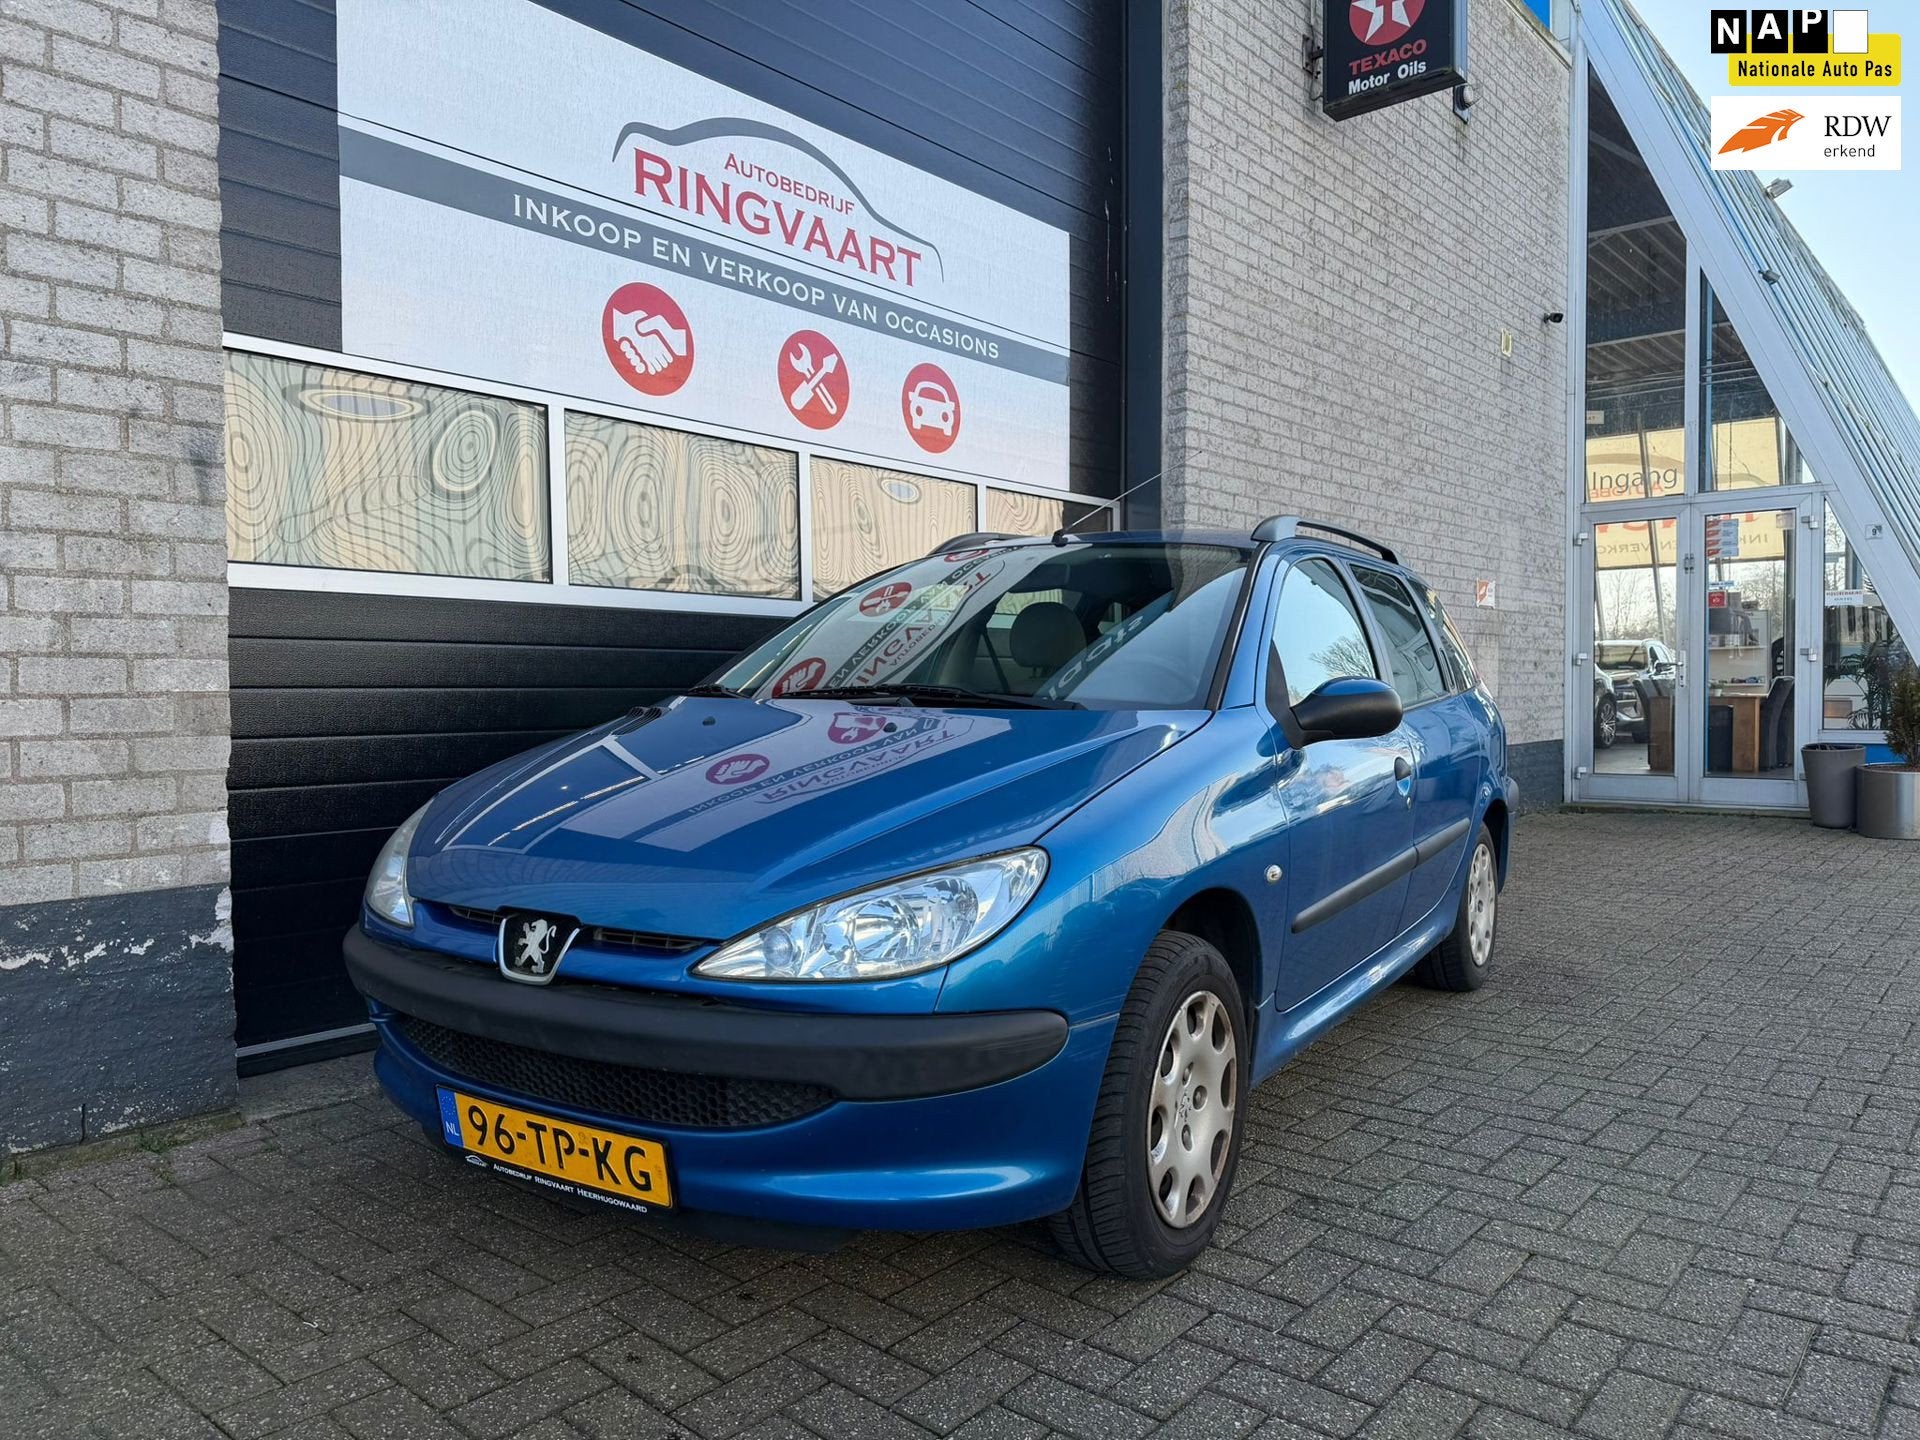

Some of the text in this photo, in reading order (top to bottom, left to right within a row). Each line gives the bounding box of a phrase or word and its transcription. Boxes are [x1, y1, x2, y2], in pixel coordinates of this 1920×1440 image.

[1348, 38, 1427, 75] TEXACO
[1348, 60, 1426, 95] Motor Oils
[724, 153, 855, 216] AUTOBEDRIJF
[634, 147, 922, 287] RINGVAART
[513, 194, 1000, 360] INKOOP EN VERKOOP VAN OCCASIONS
[1592, 467, 1678, 494] Ingang
[445, 1120, 460, 1137] NL
[467, 1104, 653, 1192] 96-TP-KG
[534, 1175, 574, 1193] RINGVAART
